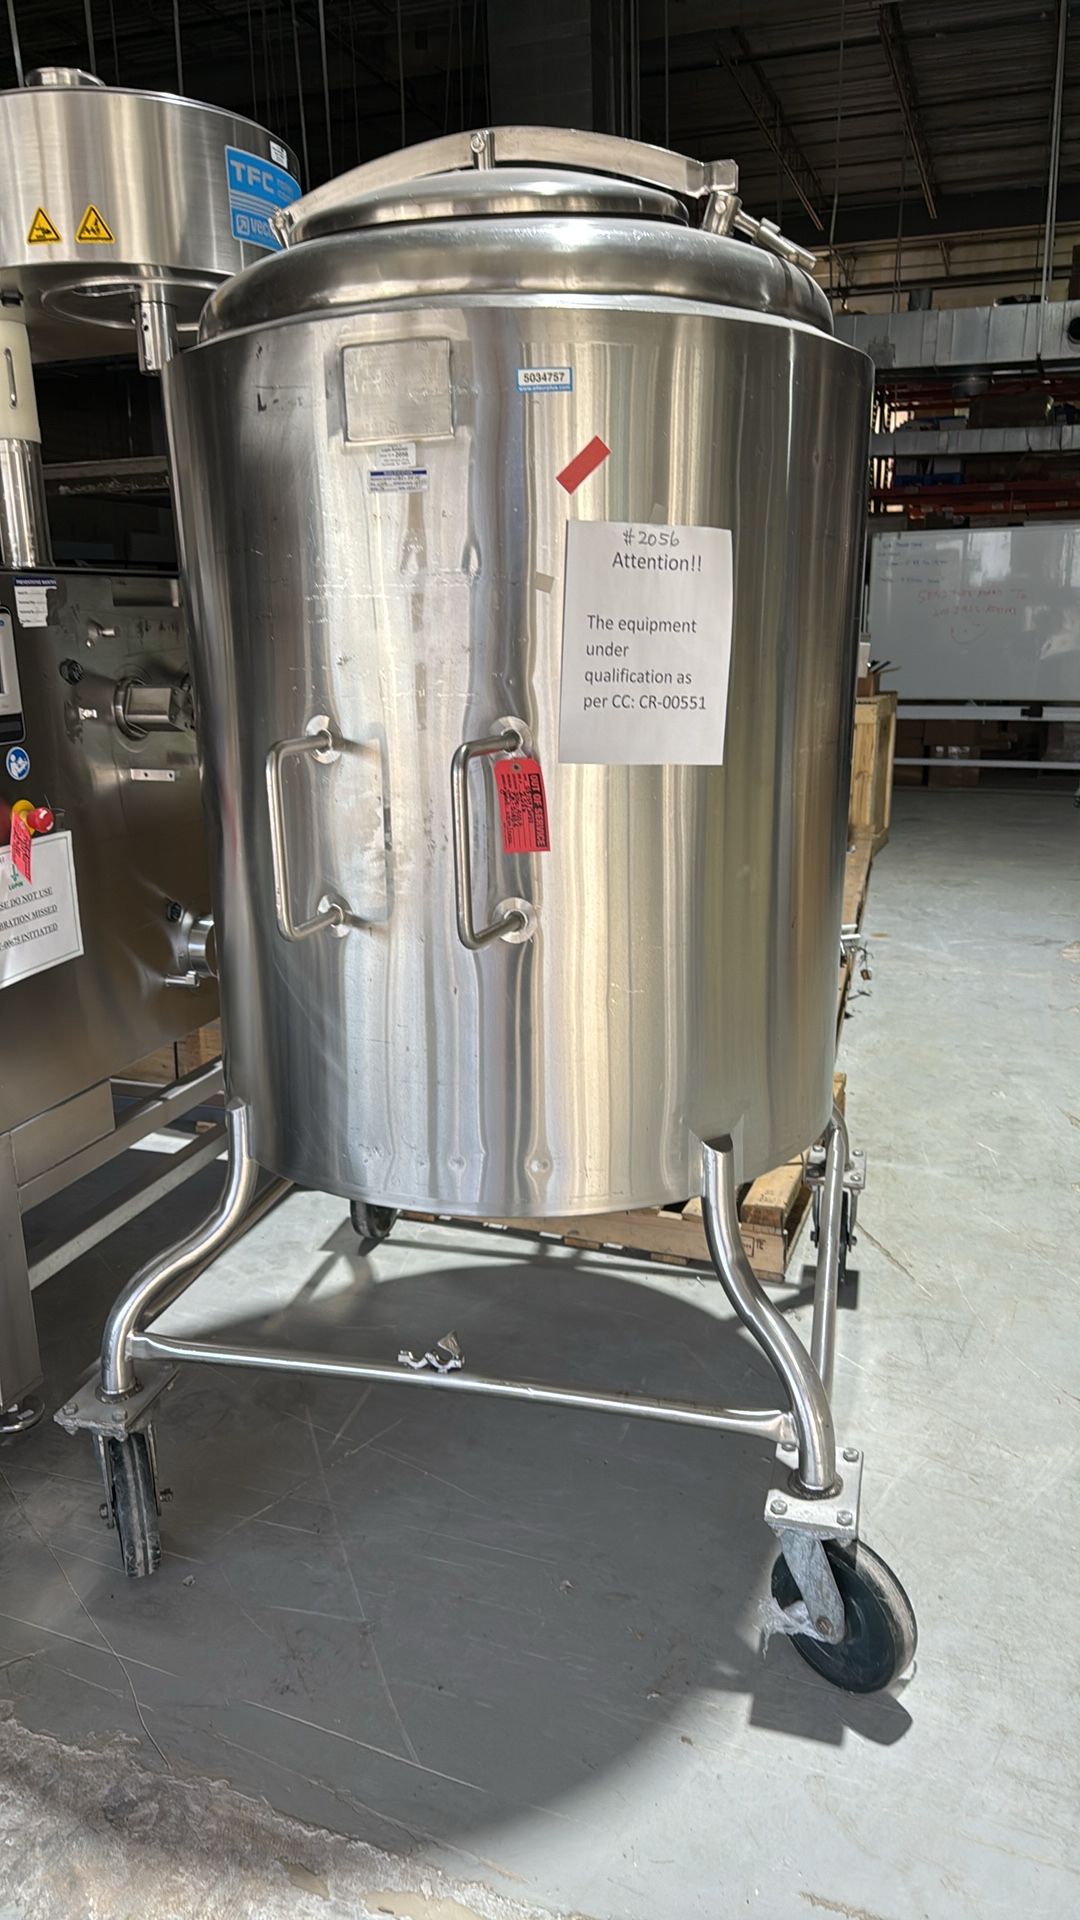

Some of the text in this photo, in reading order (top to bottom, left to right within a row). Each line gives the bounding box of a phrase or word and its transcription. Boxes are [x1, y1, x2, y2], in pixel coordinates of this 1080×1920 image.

[230, 160, 274, 194] TFC
[523, 372, 564, 383] 5034757
[612, 552, 702, 572] Attention!!
[587, 613, 697, 635] The equipment
[586, 641, 630, 657] under
[584, 668, 692, 685] qualification as
[583, 694, 706, 711] per CC: CR-00551
[530, 775, 547, 847] OUT OF SERVICE
[10, 896, 21, 908] DO
[22, 890, 38, 905] NOT
[39, 886, 53, 899] USE
[31, 903, 58, 920] MISSED
[20, 922, 58, 944] INITIATED
